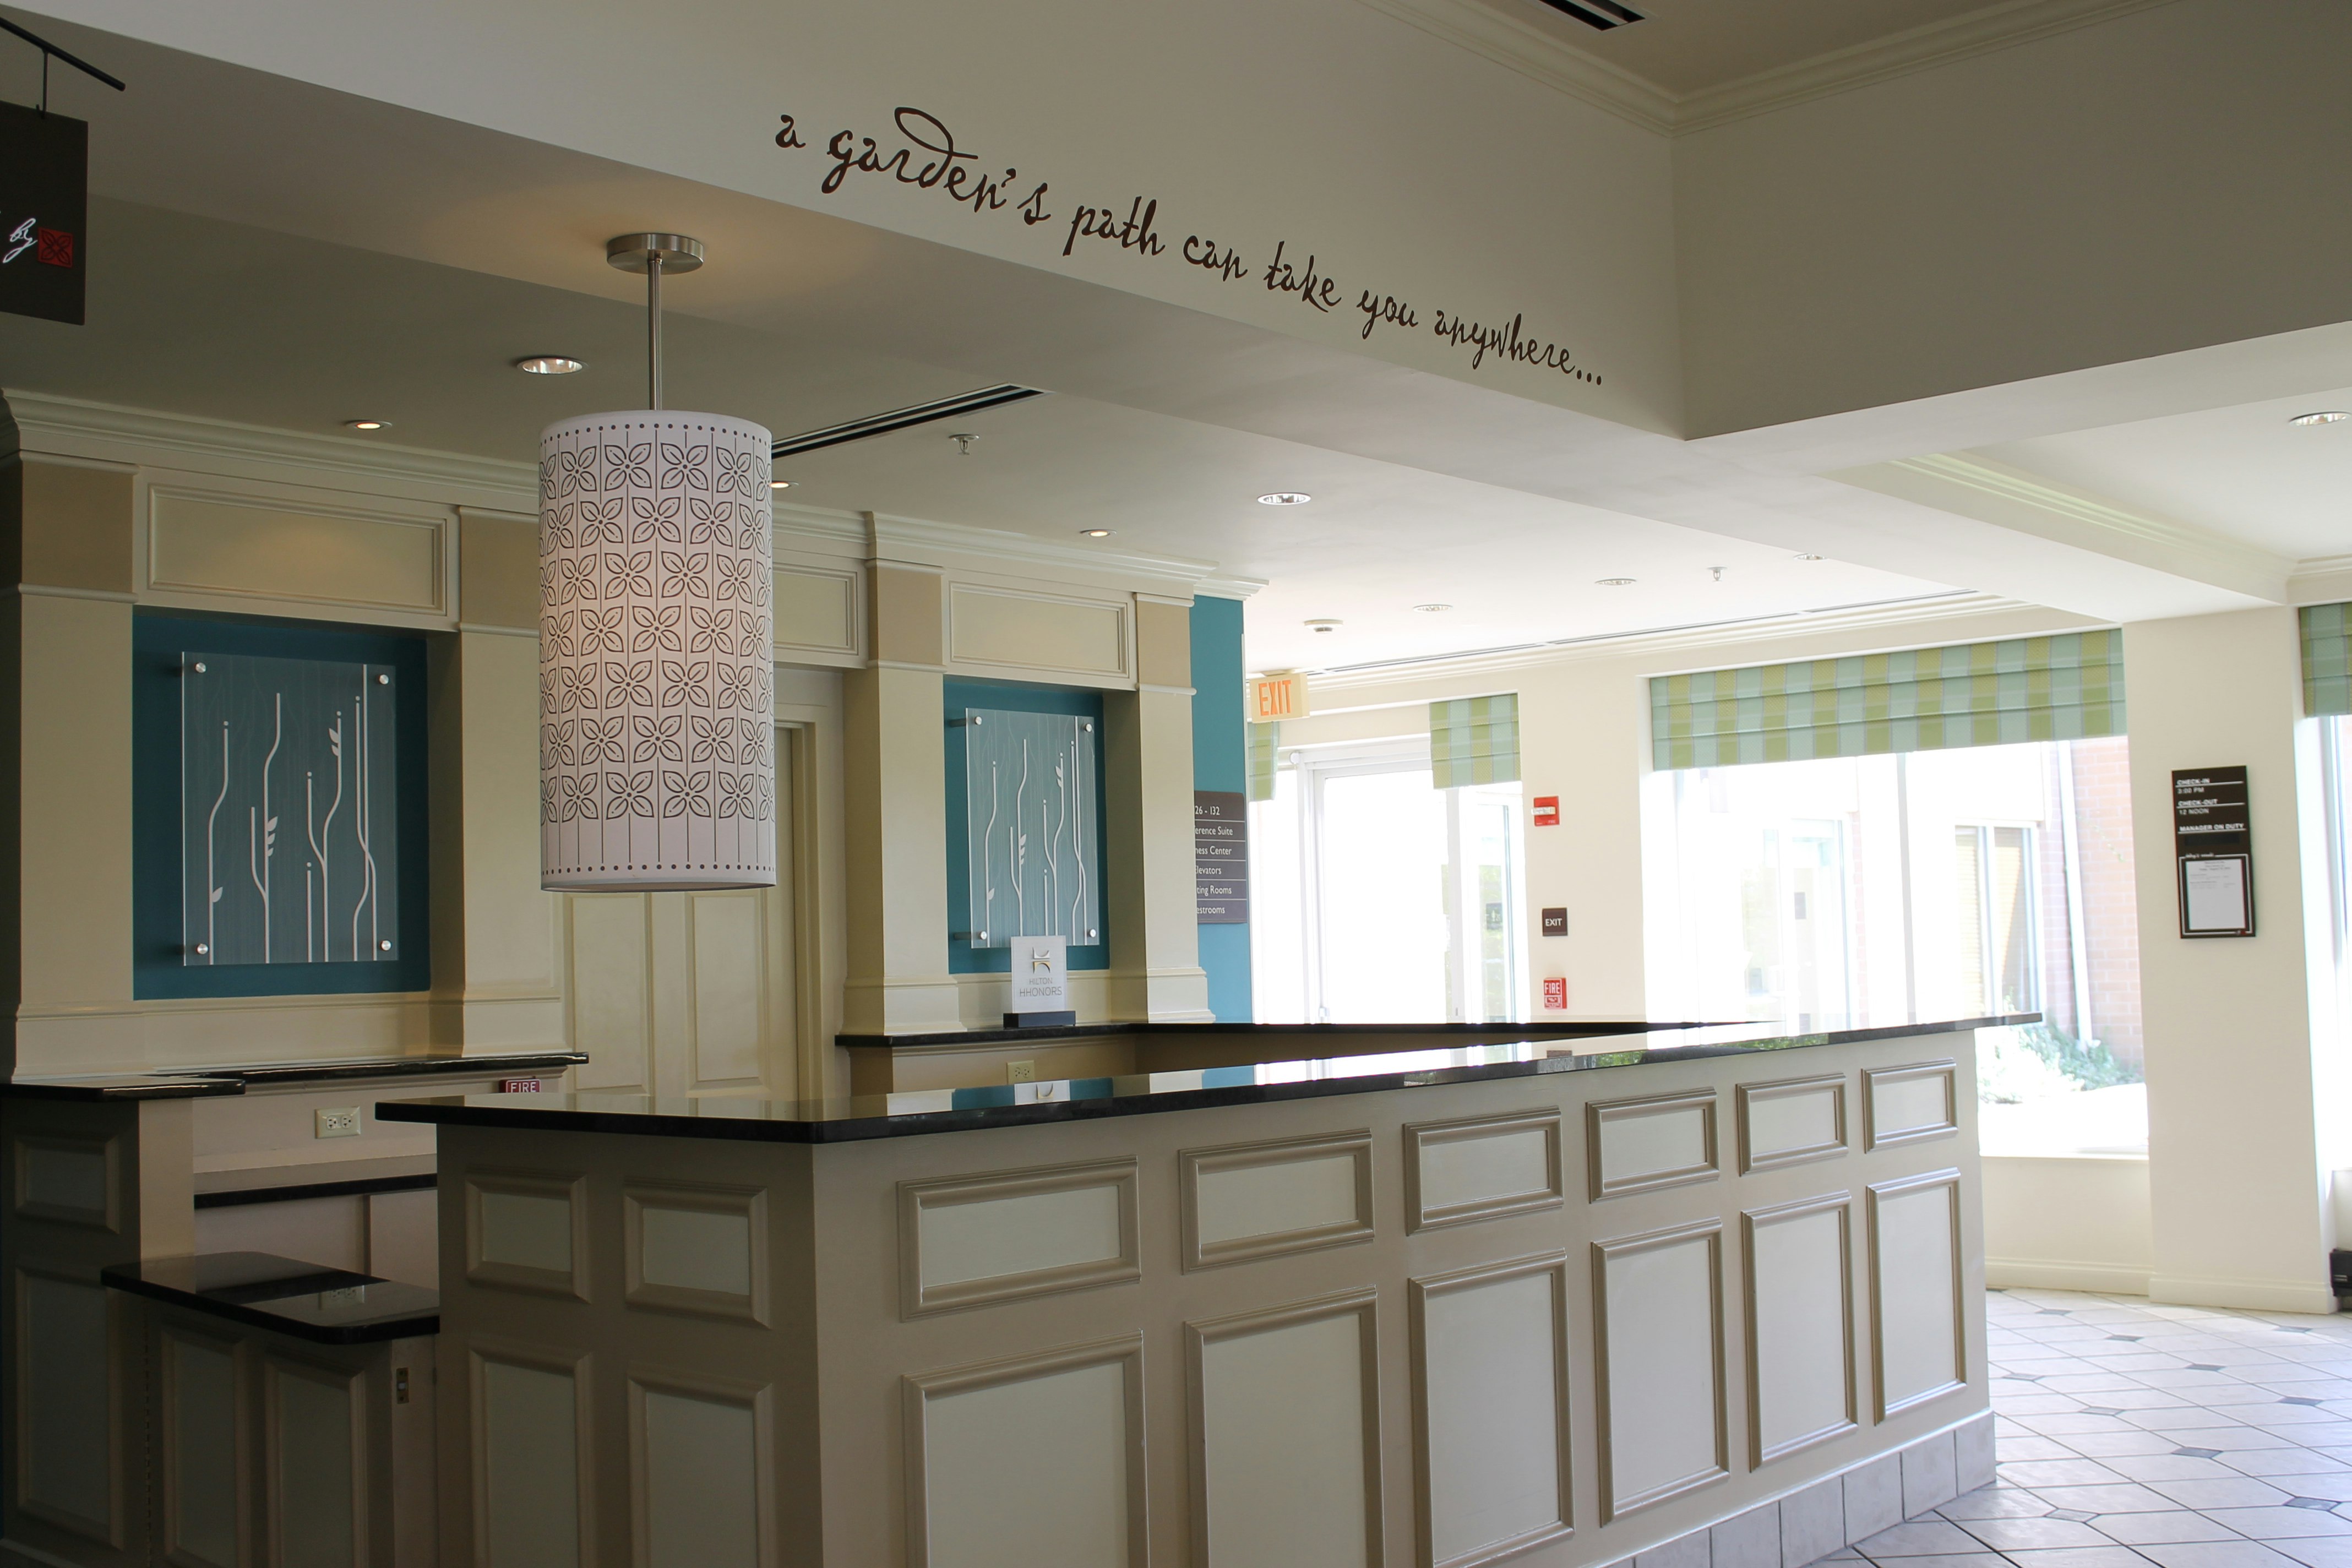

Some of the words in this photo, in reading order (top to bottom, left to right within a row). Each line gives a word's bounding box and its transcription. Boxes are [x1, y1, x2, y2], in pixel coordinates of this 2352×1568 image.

[775, 114, 806, 148] a
[821, 106, 1052, 226] garden's
[1063, 195, 1166, 257] path
[1183, 235, 1248, 281] can
[1263, 240, 1342, 313] take
[1357, 290, 1419, 339] you
[1434, 309, 1603, 386] anywhere...
[1258, 679, 1292, 716] EXIT
[1210, 805, 1220, 815] 132
[1195, 826, 1216, 835] erence
[1218, 826, 1233, 836] Suite
[1210, 846, 1232, 855] Center
[1210, 885, 1232, 894] Rooms
[1545, 918, 1562, 927] EXIT
[1020, 986, 1062, 997] HHONORS
[1545, 982, 1560, 994] FIRE
[510, 1081, 537, 1093] FIRE
